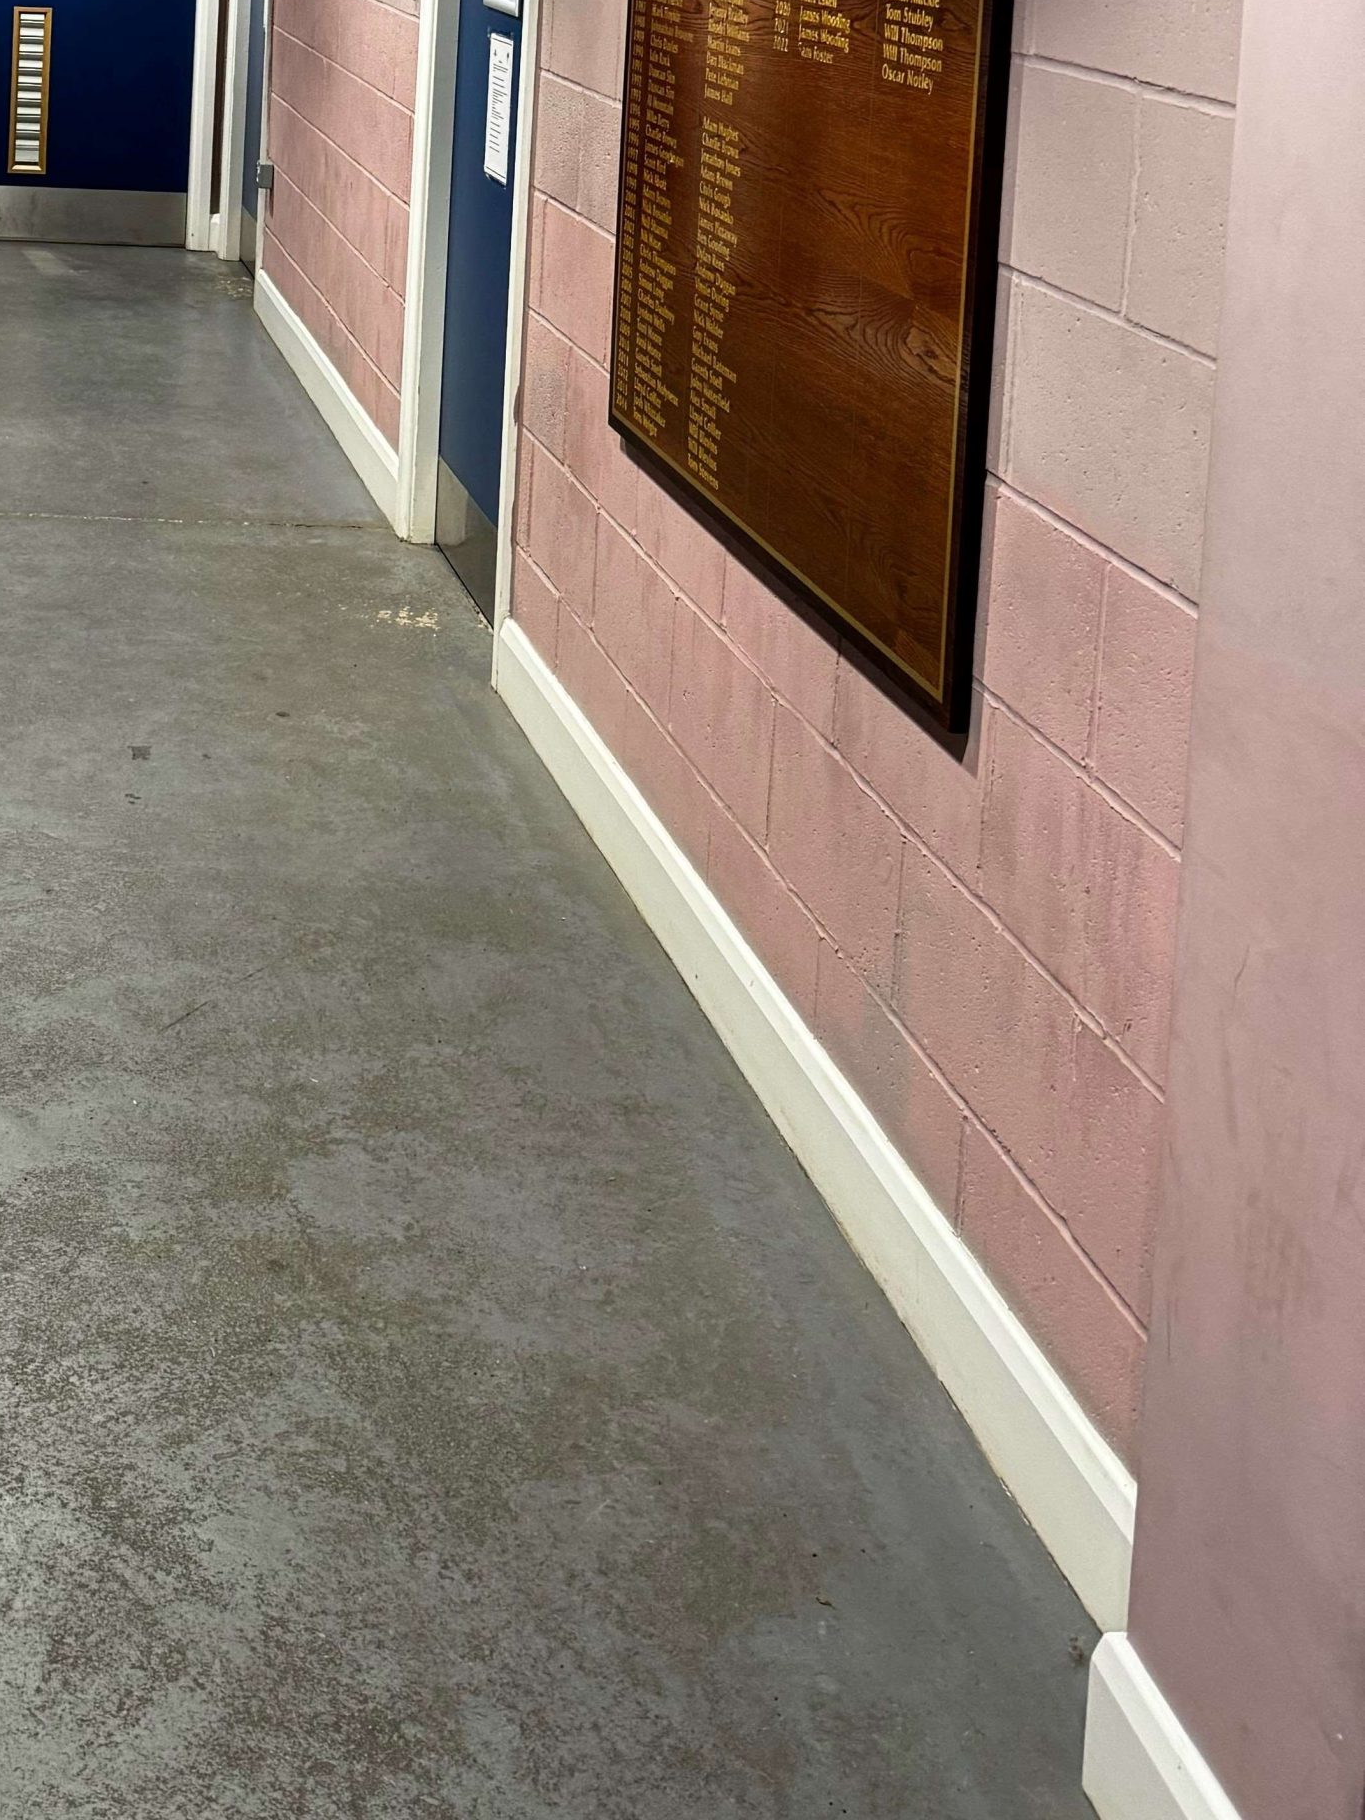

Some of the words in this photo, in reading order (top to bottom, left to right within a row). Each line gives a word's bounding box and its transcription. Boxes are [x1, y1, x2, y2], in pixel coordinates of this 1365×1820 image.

[800, 6, 820, 23] James
[885, 3, 901, 20] Tom
[903, 6, 933, 32] Stubley
[884, 23, 899, 41] Will
[901, 26, 943, 52] Thompson
[883, 43, 898, 61] Will
[900, 47, 942, 73] Thompson
[882, 63, 905, 84] Oscar
